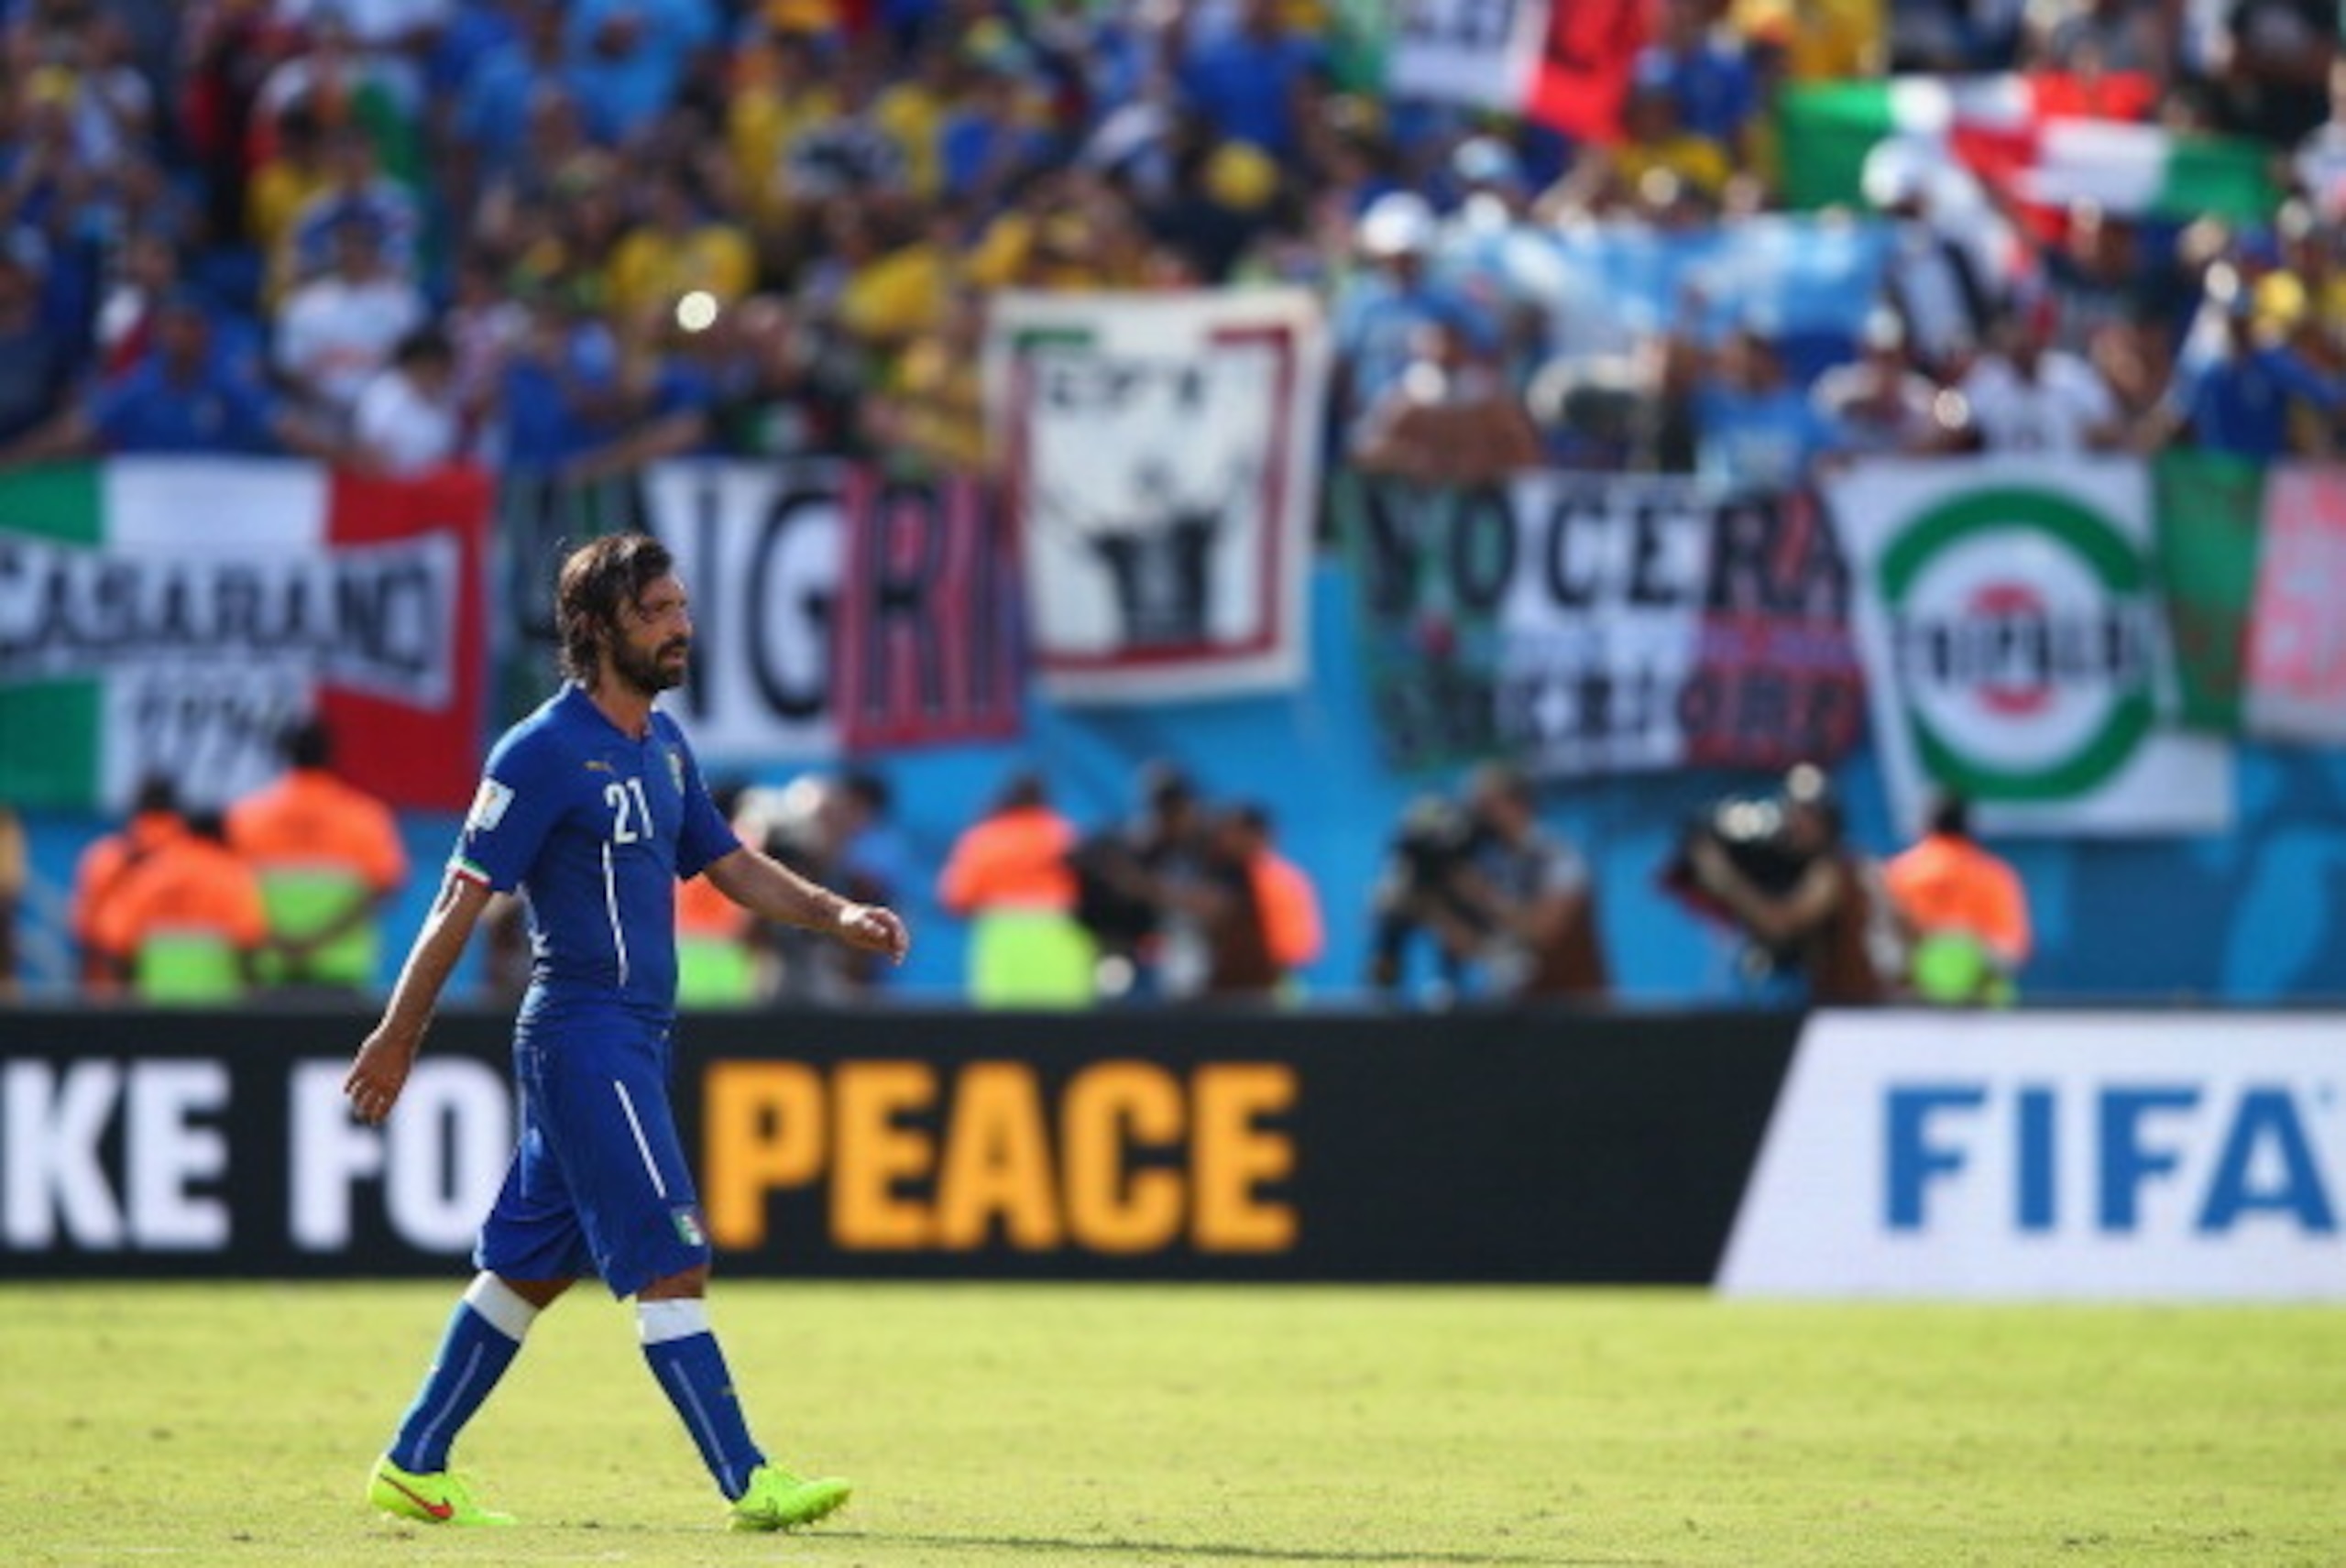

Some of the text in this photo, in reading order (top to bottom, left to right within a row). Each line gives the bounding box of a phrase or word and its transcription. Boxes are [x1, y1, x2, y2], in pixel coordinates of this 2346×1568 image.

[605, 778, 653, 843] 21
[0, 1058, 1298, 1252] KE FO PEACE
[1882, 1083, 2339, 1234] FIFA
